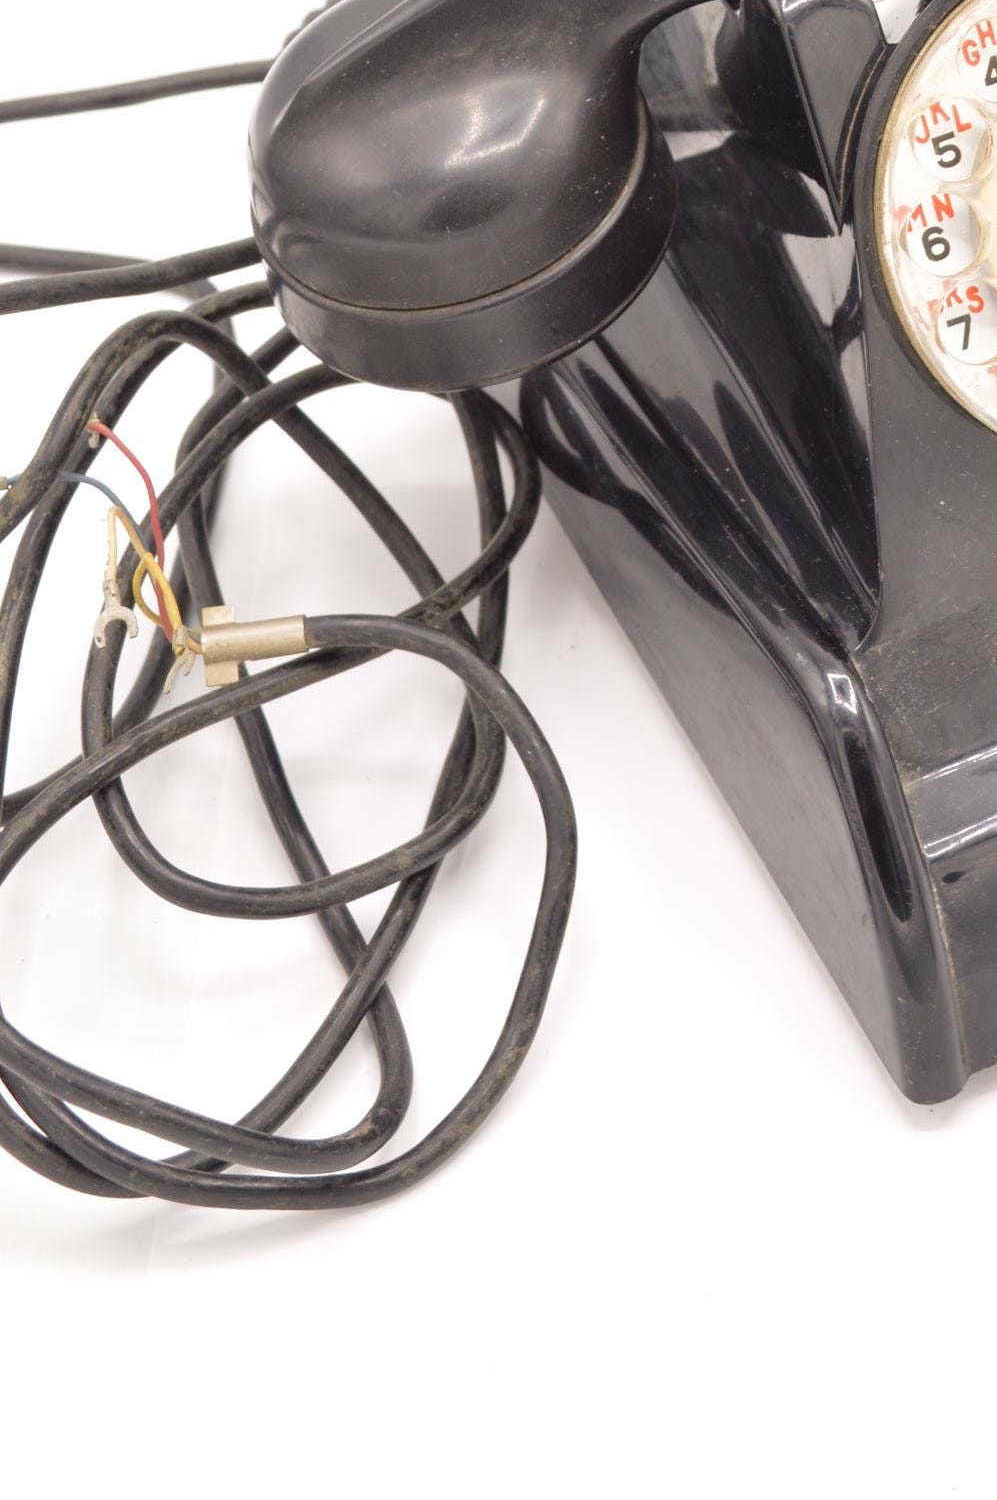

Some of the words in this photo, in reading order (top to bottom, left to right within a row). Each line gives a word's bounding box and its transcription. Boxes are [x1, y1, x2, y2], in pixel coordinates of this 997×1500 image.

[931, 130, 962, 169] 5
[921, 226, 951, 262] 6
[946, 313, 972, 351] 7
